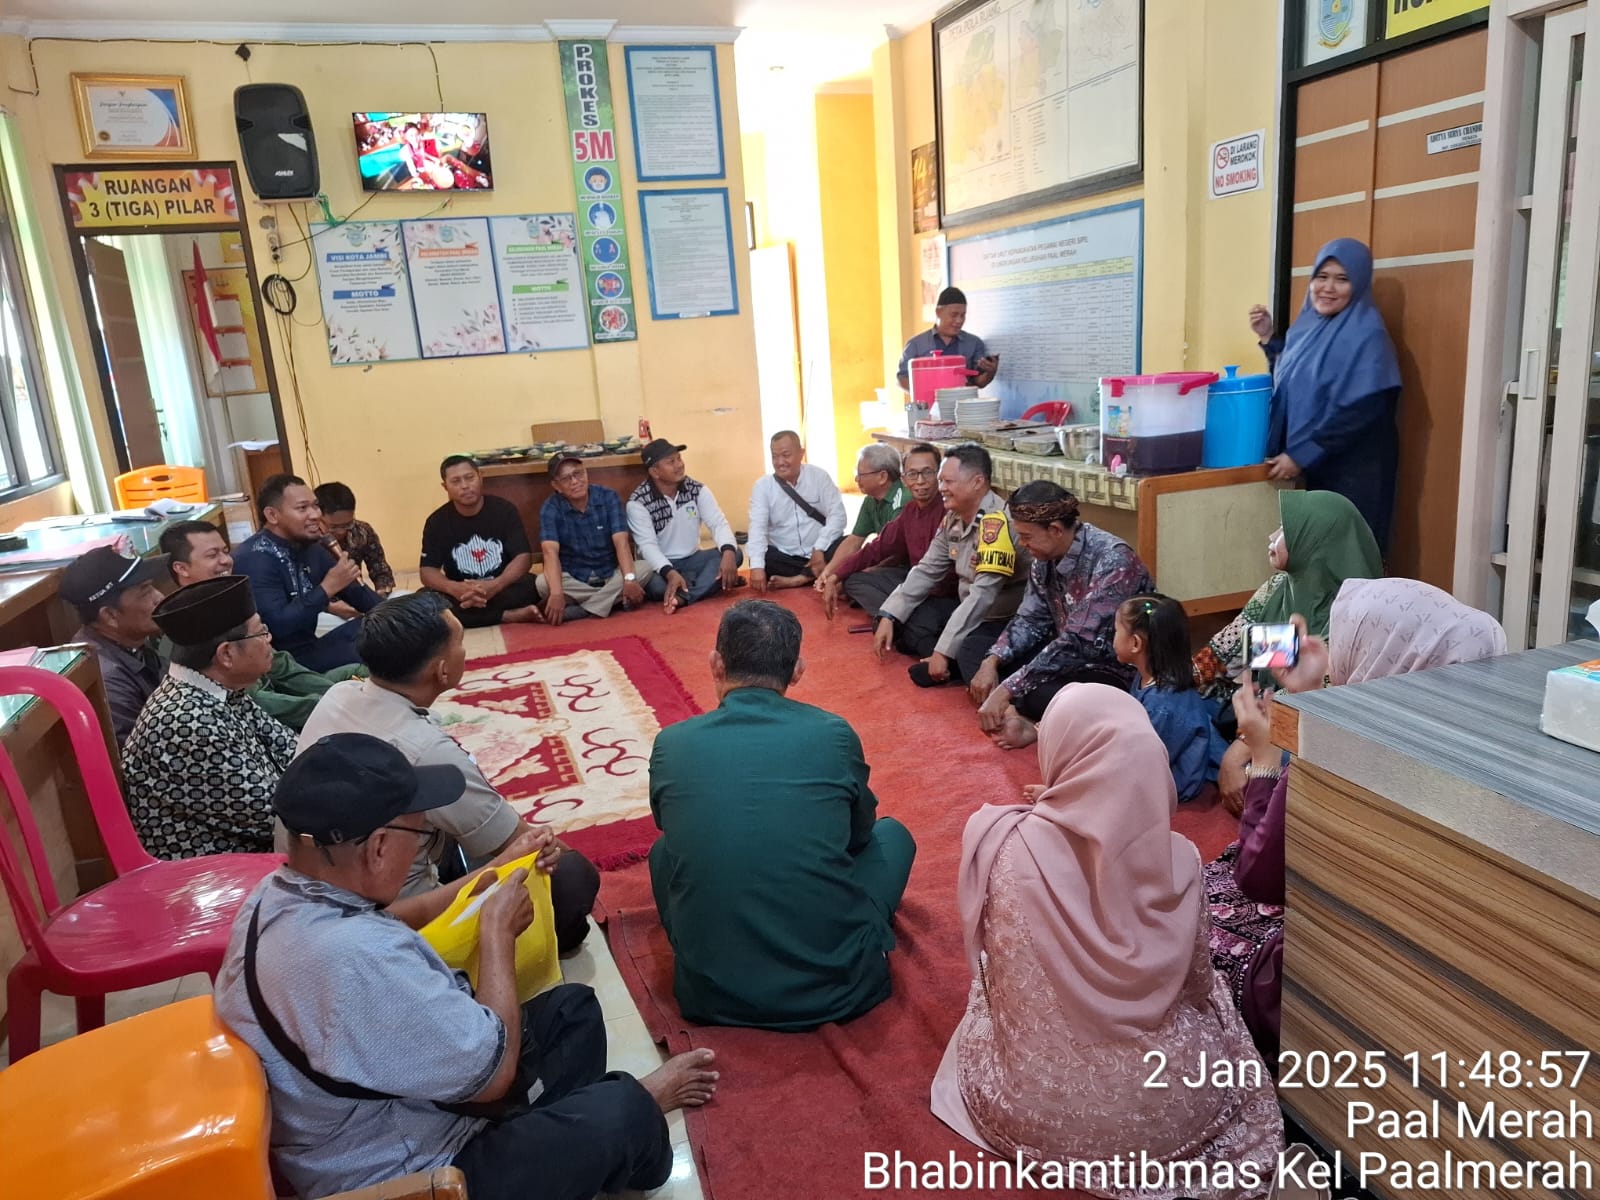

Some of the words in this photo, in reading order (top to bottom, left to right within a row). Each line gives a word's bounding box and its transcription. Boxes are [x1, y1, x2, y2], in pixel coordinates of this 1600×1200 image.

[574, 45, 599, 127] PROKES
[574, 130, 614, 161] 5M
[1236, 139, 1257, 153] LARANG
[1230, 151, 1257, 165] MEROKOK
[104, 178, 192, 195] RUANGAN
[1215, 175, 1225, 188] NO
[1225, 167, 1257, 186] SMOKING
[89, 202, 100, 217] 3
[105, 199, 160, 221] (TIGA)
[165, 199, 216, 215] PILAR
[365, 252, 388, 260] JAMBI
